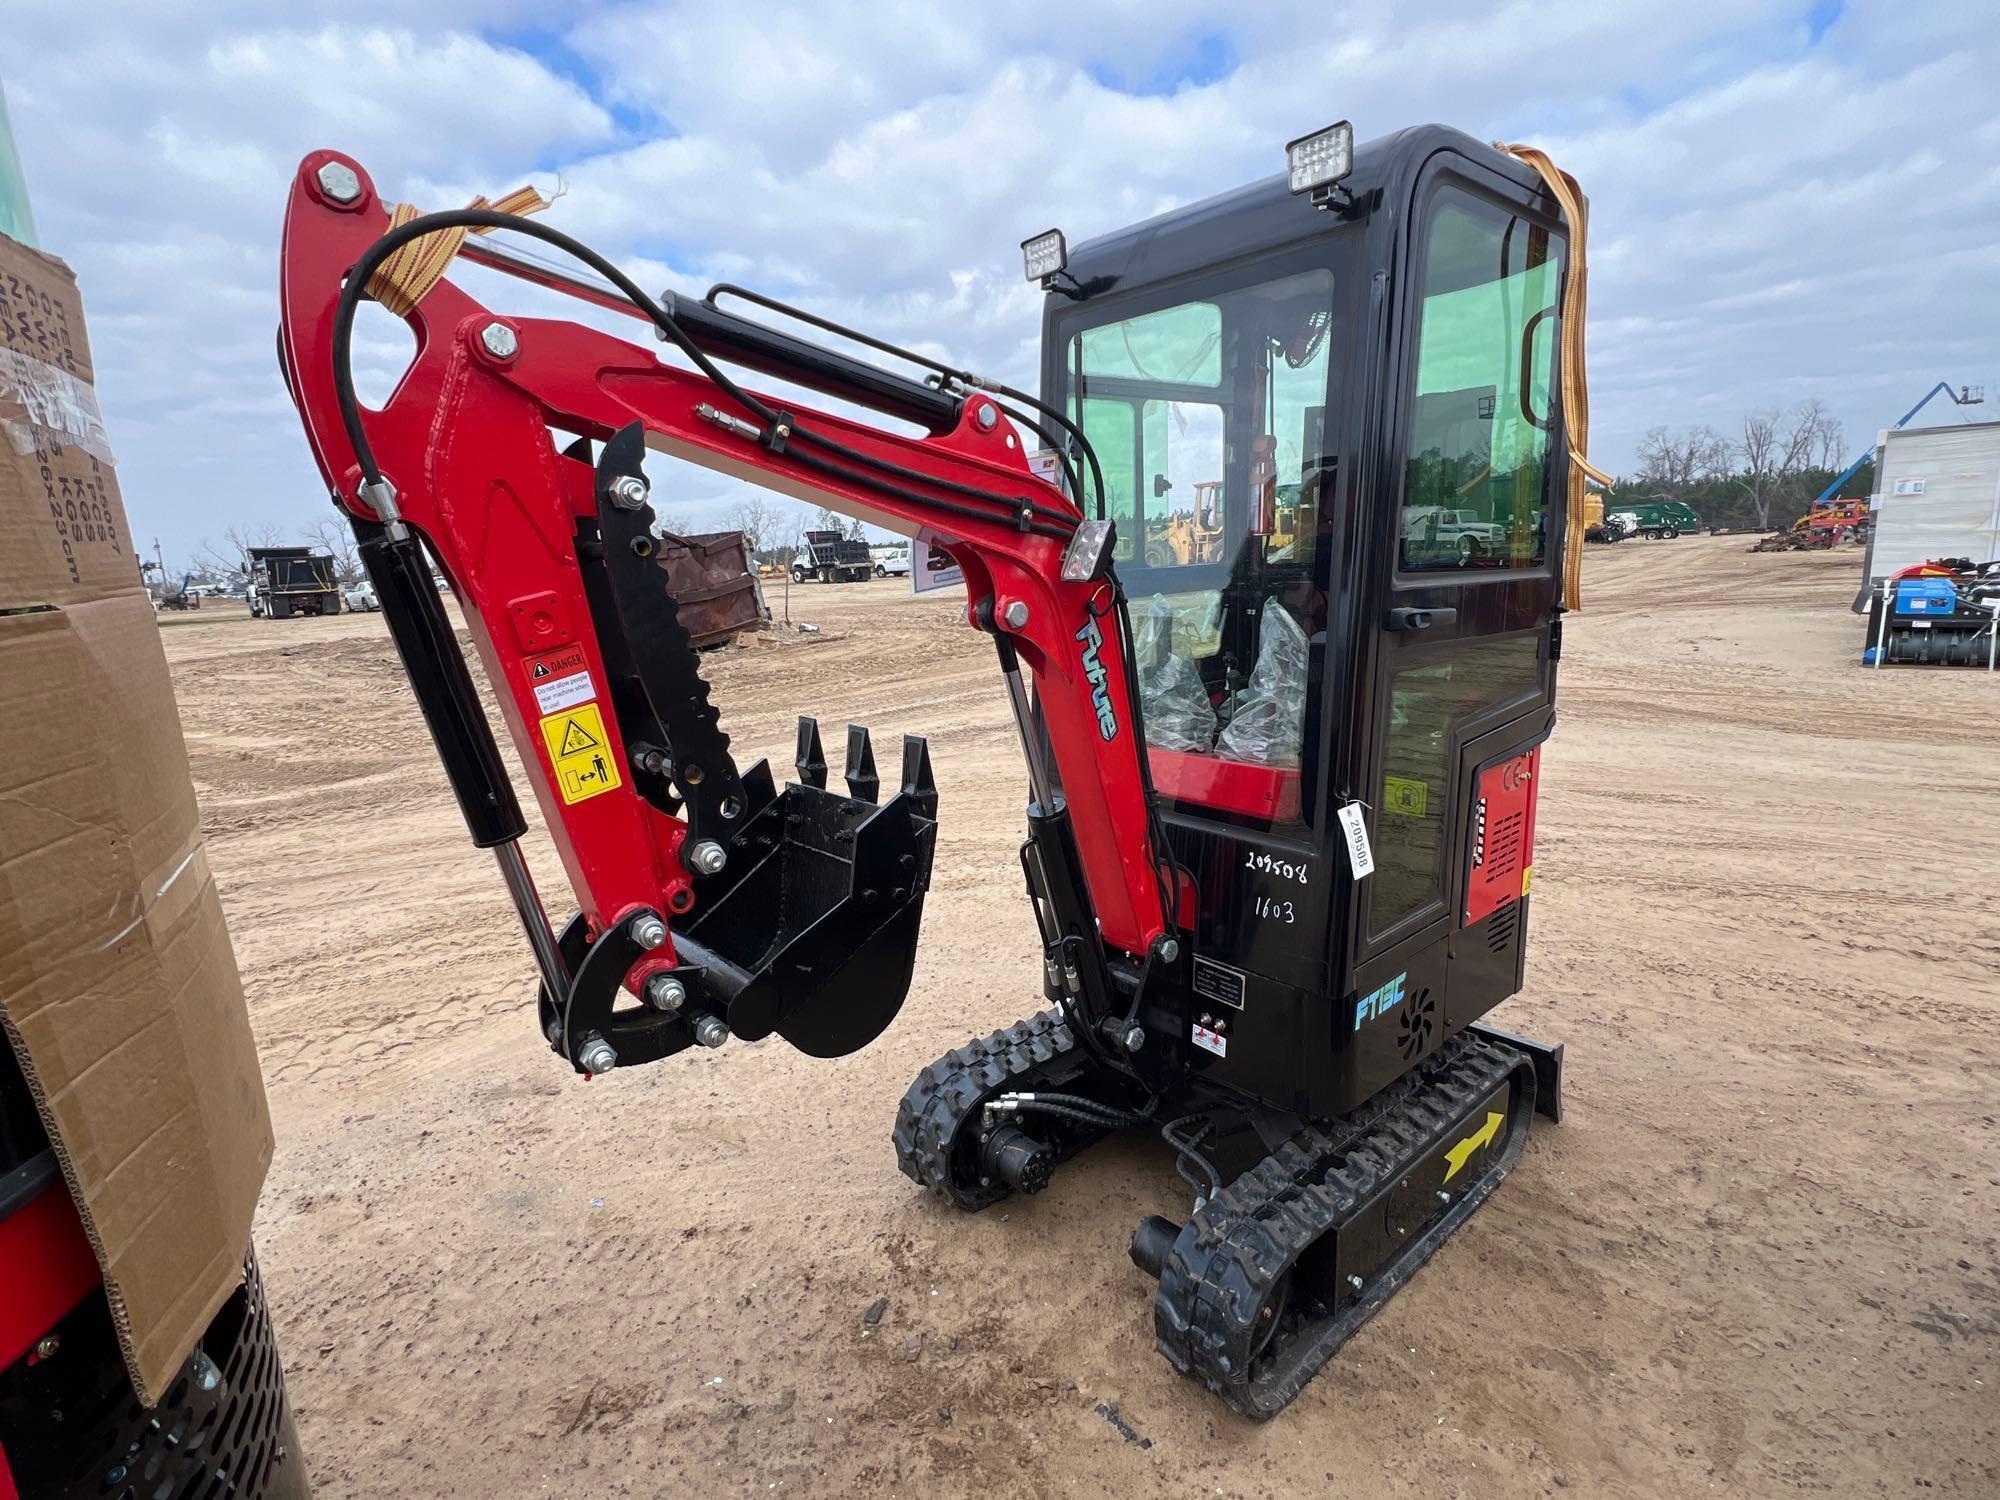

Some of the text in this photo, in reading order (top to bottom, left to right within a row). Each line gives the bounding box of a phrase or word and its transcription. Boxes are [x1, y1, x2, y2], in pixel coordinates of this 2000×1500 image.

[58, 476, 83, 543] KGS
[73, 478, 95, 543] KGS
[87, 482, 107, 542] PCS
[551, 654, 582, 672] DANGER
[1074, 613, 1119, 742] Future
[536, 687, 546, 695] Do
[556, 680, 570, 689] allow
[570, 674, 588, 686] people
[553, 688, 575, 698] machine
[575, 683, 589, 691] when
[1350, 819, 1368, 868] 209508
[1245, 851, 1308, 884] 209508
[1255, 896, 1295, 924] 1603
